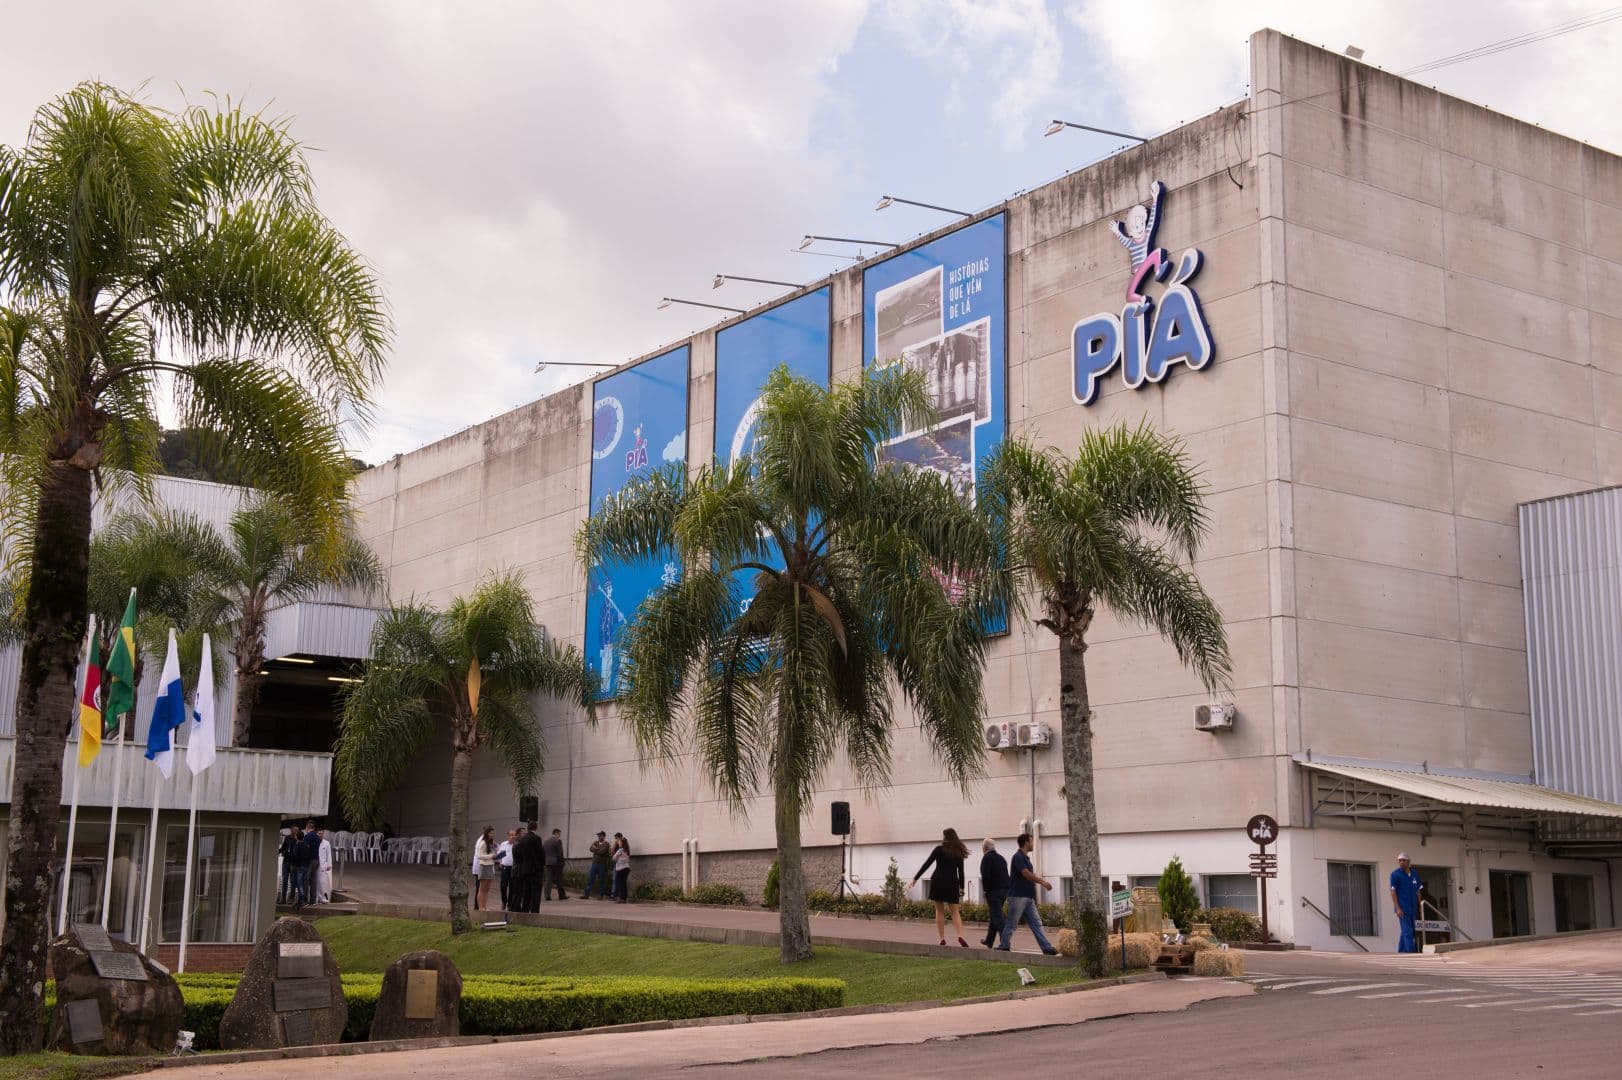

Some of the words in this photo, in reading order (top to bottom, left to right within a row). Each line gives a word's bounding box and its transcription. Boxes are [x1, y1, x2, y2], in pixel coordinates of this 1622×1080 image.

[949, 257, 989, 285] HISTÓRIAS
[949, 284, 963, 302] QUE
[966, 277, 982, 295] VÊM
[949, 303, 959, 320] DE
[961, 296, 971, 316] LÁ
[1071, 248, 1214, 405] PIÁ
